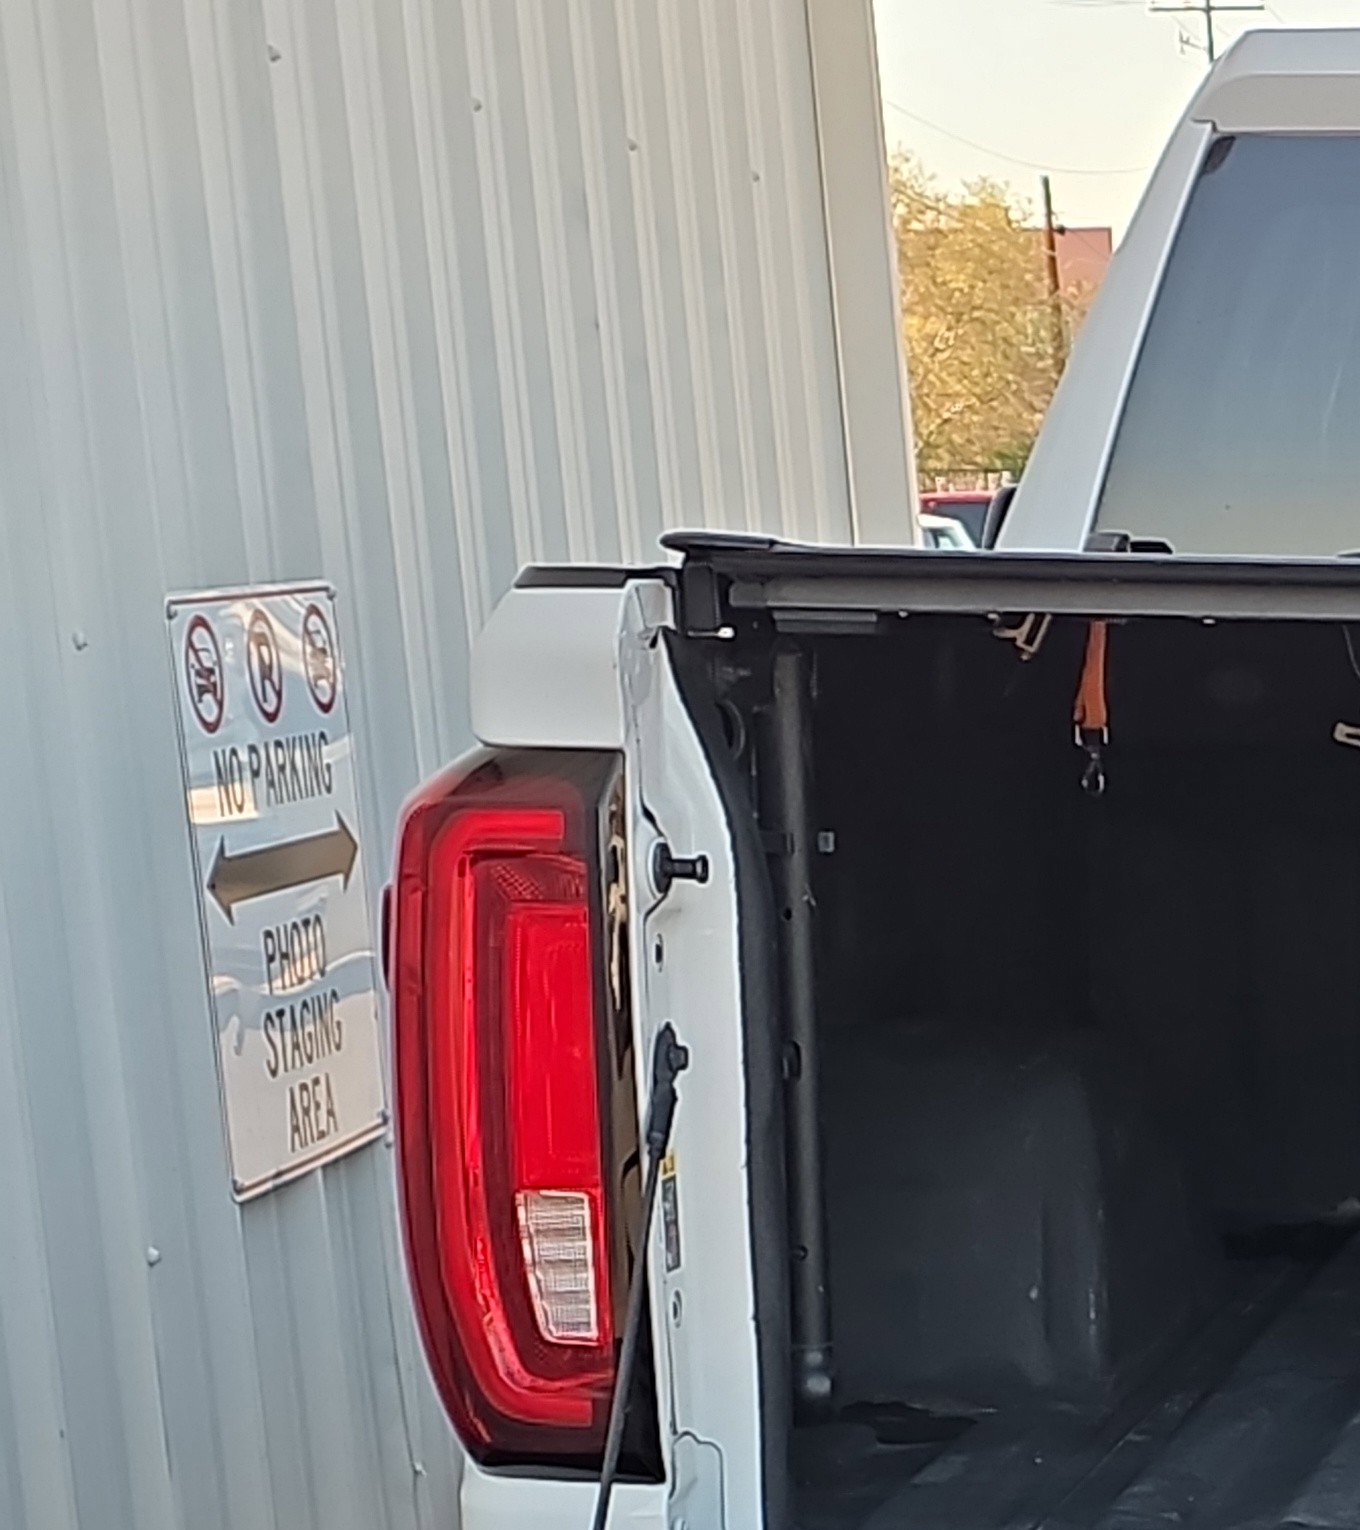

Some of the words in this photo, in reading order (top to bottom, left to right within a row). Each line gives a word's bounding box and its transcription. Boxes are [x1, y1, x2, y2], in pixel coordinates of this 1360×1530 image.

[213, 745, 246, 817] NO
[248, 731, 333, 808] PARKING
[262, 914, 326, 995] PHOTO
[264, 988, 342, 1080] STAGING
[288, 1073, 338, 1153] AREA
